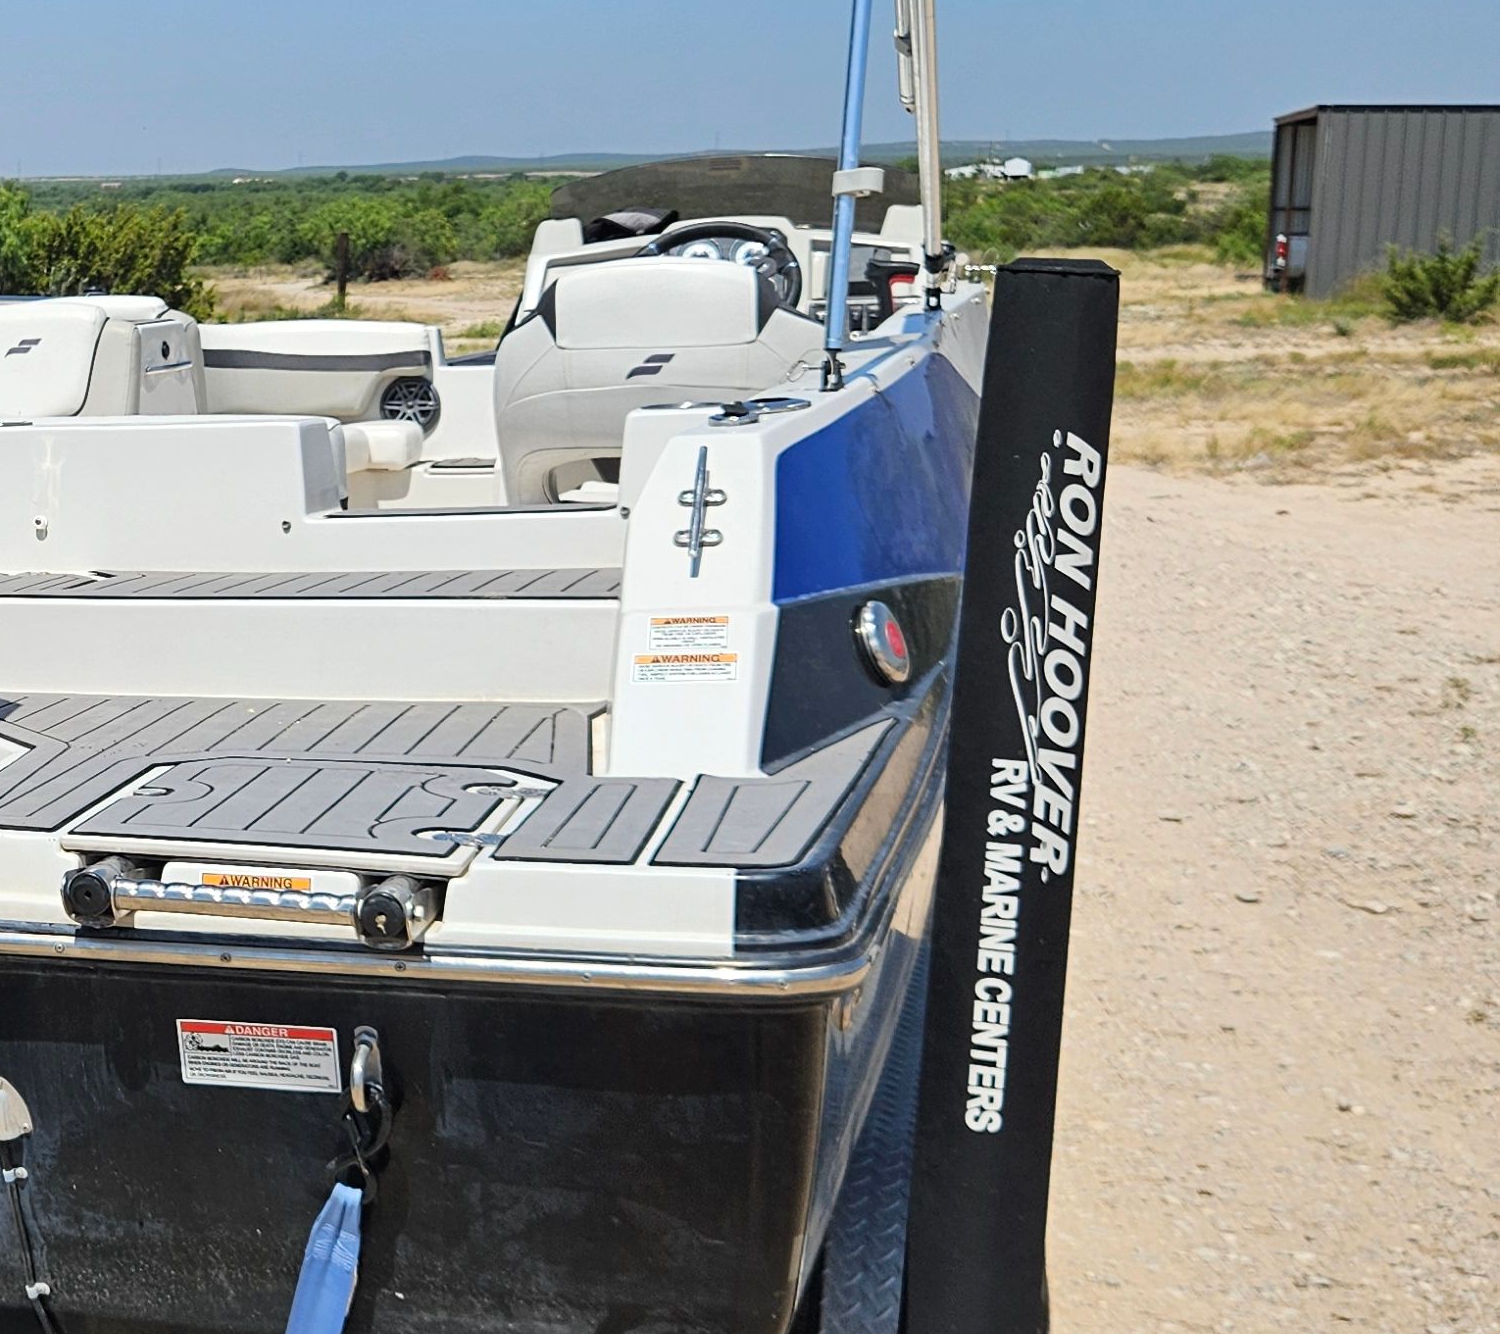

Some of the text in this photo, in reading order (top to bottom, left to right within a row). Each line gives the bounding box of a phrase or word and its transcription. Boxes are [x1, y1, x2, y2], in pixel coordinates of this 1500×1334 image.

[660, 654, 720, 663] WARNING
[1029, 430, 1101, 876] RON HOOVER
[230, 875, 293, 889] WARNING
[964, 758, 1028, 1134] RV & MARINE CENTERS
[236, 1025, 289, 1037] DANGER
